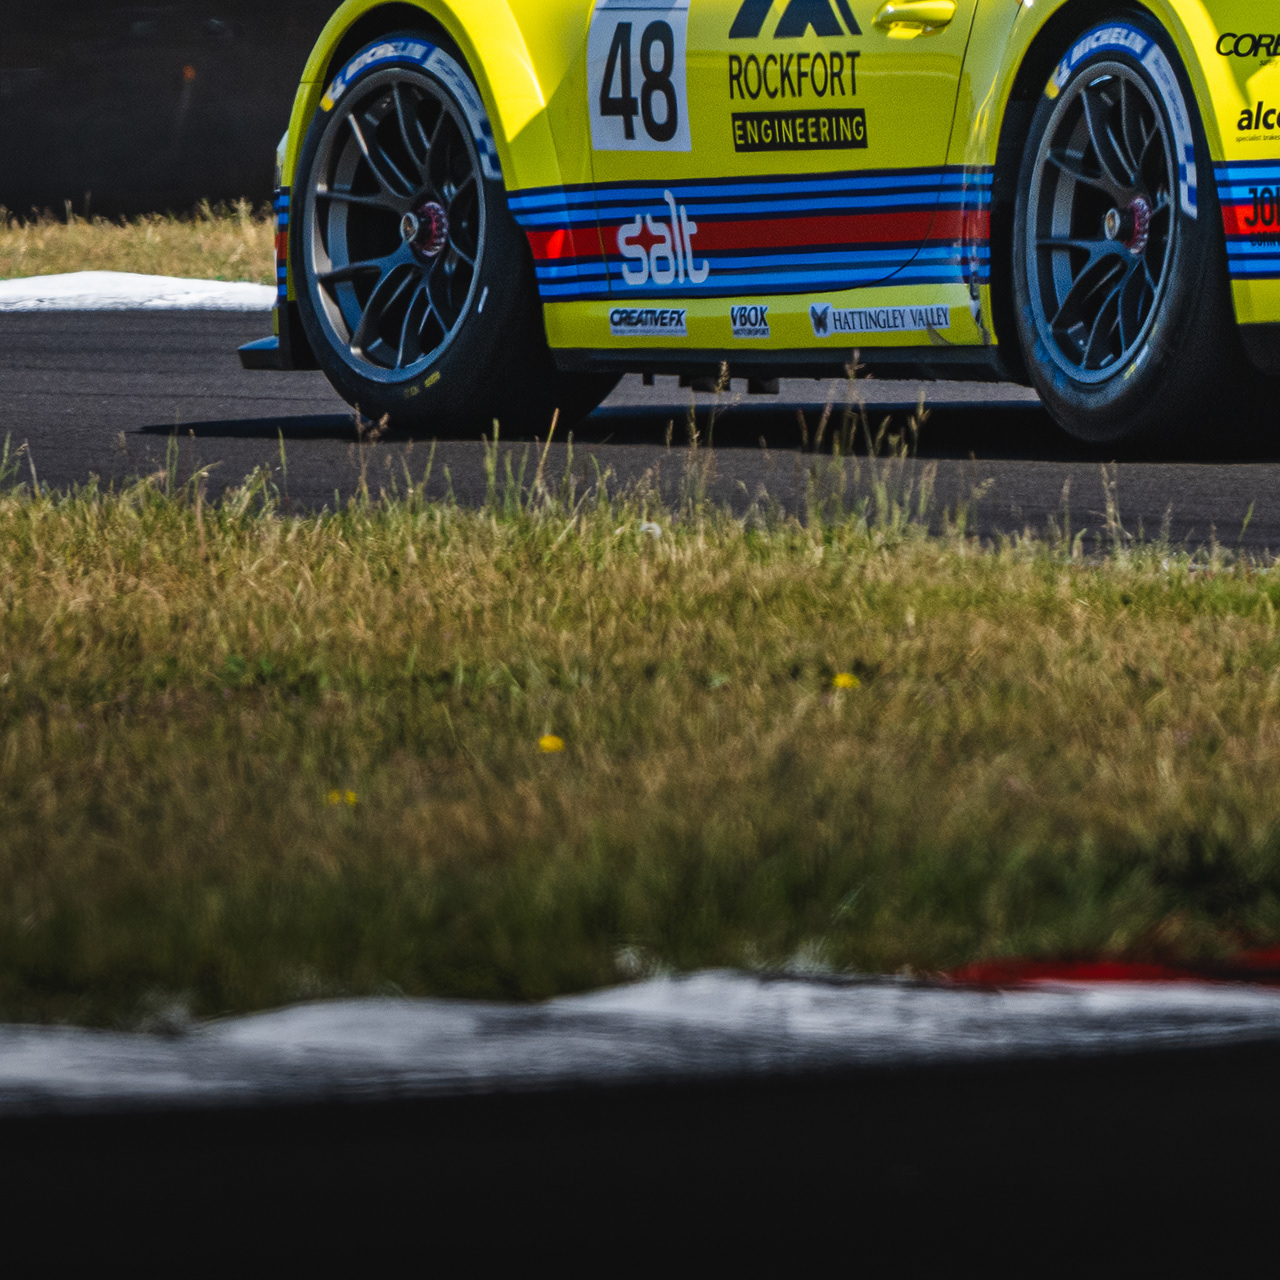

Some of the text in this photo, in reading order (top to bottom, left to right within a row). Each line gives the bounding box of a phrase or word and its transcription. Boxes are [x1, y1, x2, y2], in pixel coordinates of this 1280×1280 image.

[1070, 27, 1149, 66] MICHELIN
[600, 20, 679, 142] 48
[728, 51, 861, 100] ROCKFORT
[734, 116, 865, 144] ENGINEERING
[1236, 134, 1262, 143] specialist
[1263, 133, 1280, 142] brakes
[617, 189, 709, 285] salt
[731, 306, 768, 326] VBOX
[833, 306, 950, 330] HATTINGLEY VALLEY
